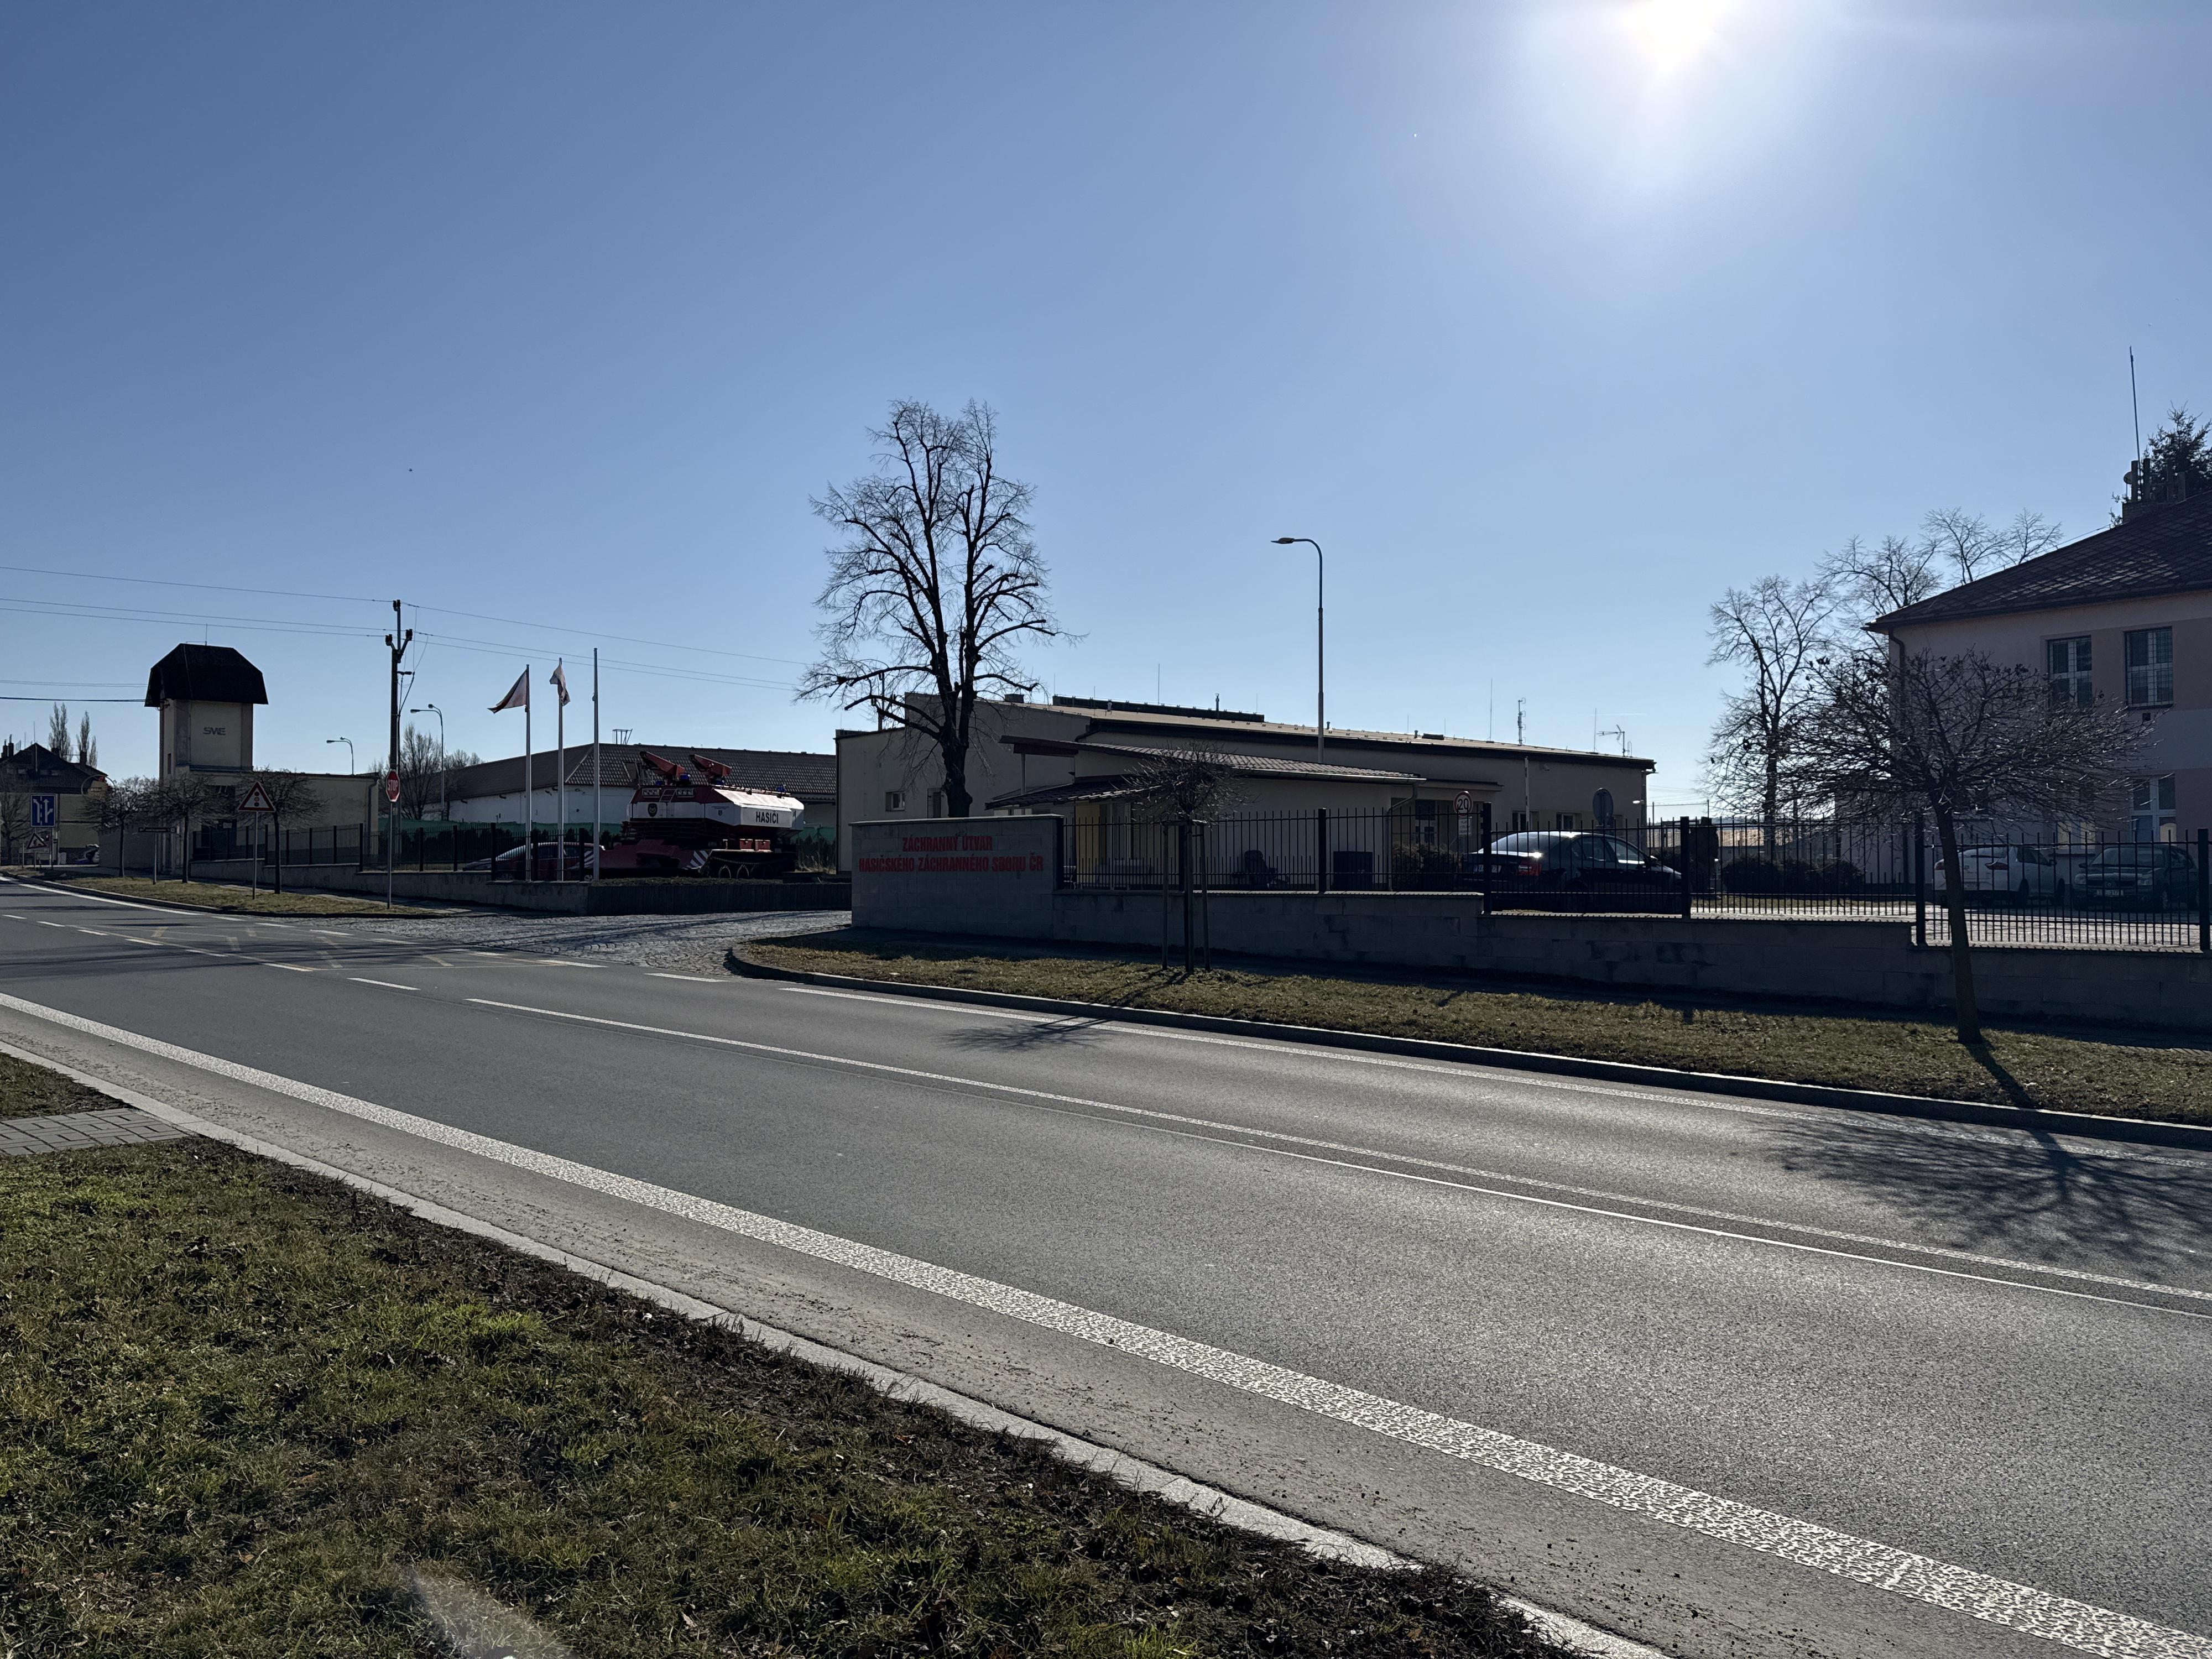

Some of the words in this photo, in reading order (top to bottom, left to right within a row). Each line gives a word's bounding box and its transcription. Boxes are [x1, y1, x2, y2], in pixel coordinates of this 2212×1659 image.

[388, 780, 398, 791] STOP
[1458, 798, 1468, 810] 20
[902, 833, 958, 852] ZÁCHRANNÝ
[962, 833, 993, 851] ÚTVAR
[859, 854, 914, 872] HASIČSKÉHO
[918, 854, 989, 872] ZÁCHRANNÉHO
[992, 856, 1027, 872] SBORU
[1029, 852, 1044, 872] ČR
